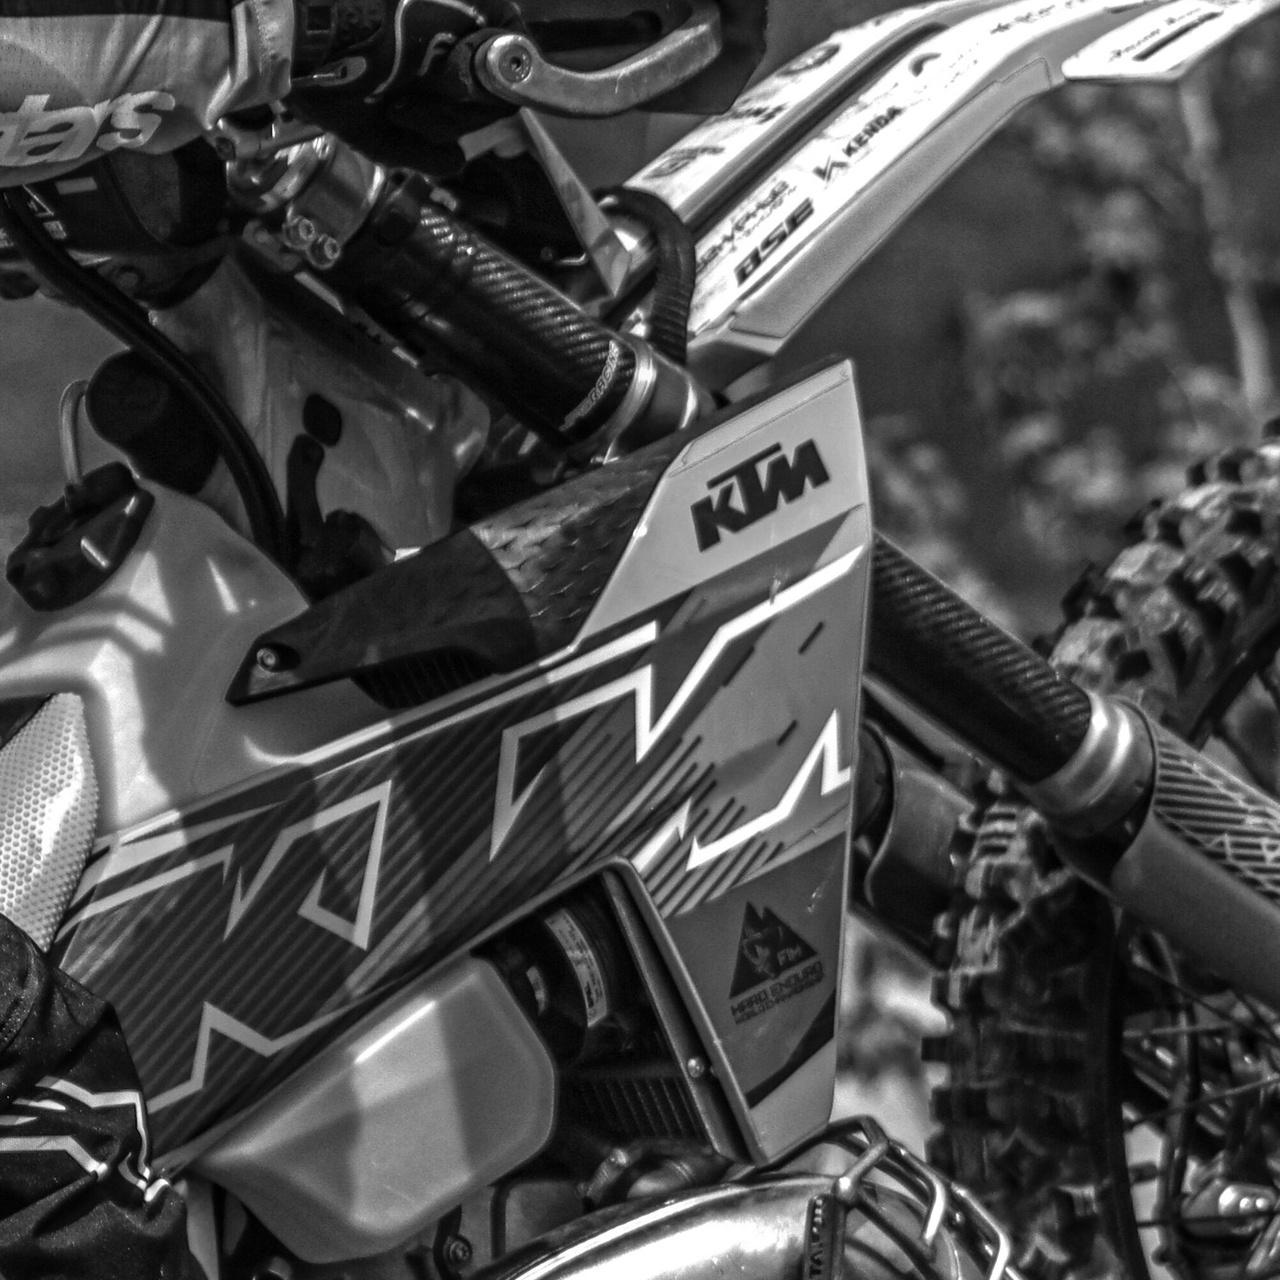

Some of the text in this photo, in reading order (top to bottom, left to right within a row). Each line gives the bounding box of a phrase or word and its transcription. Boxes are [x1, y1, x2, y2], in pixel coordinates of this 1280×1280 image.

[842, 105, 903, 157] KENDA
[733, 196, 815, 288] BSE
[690, 437, 831, 553] KTM
